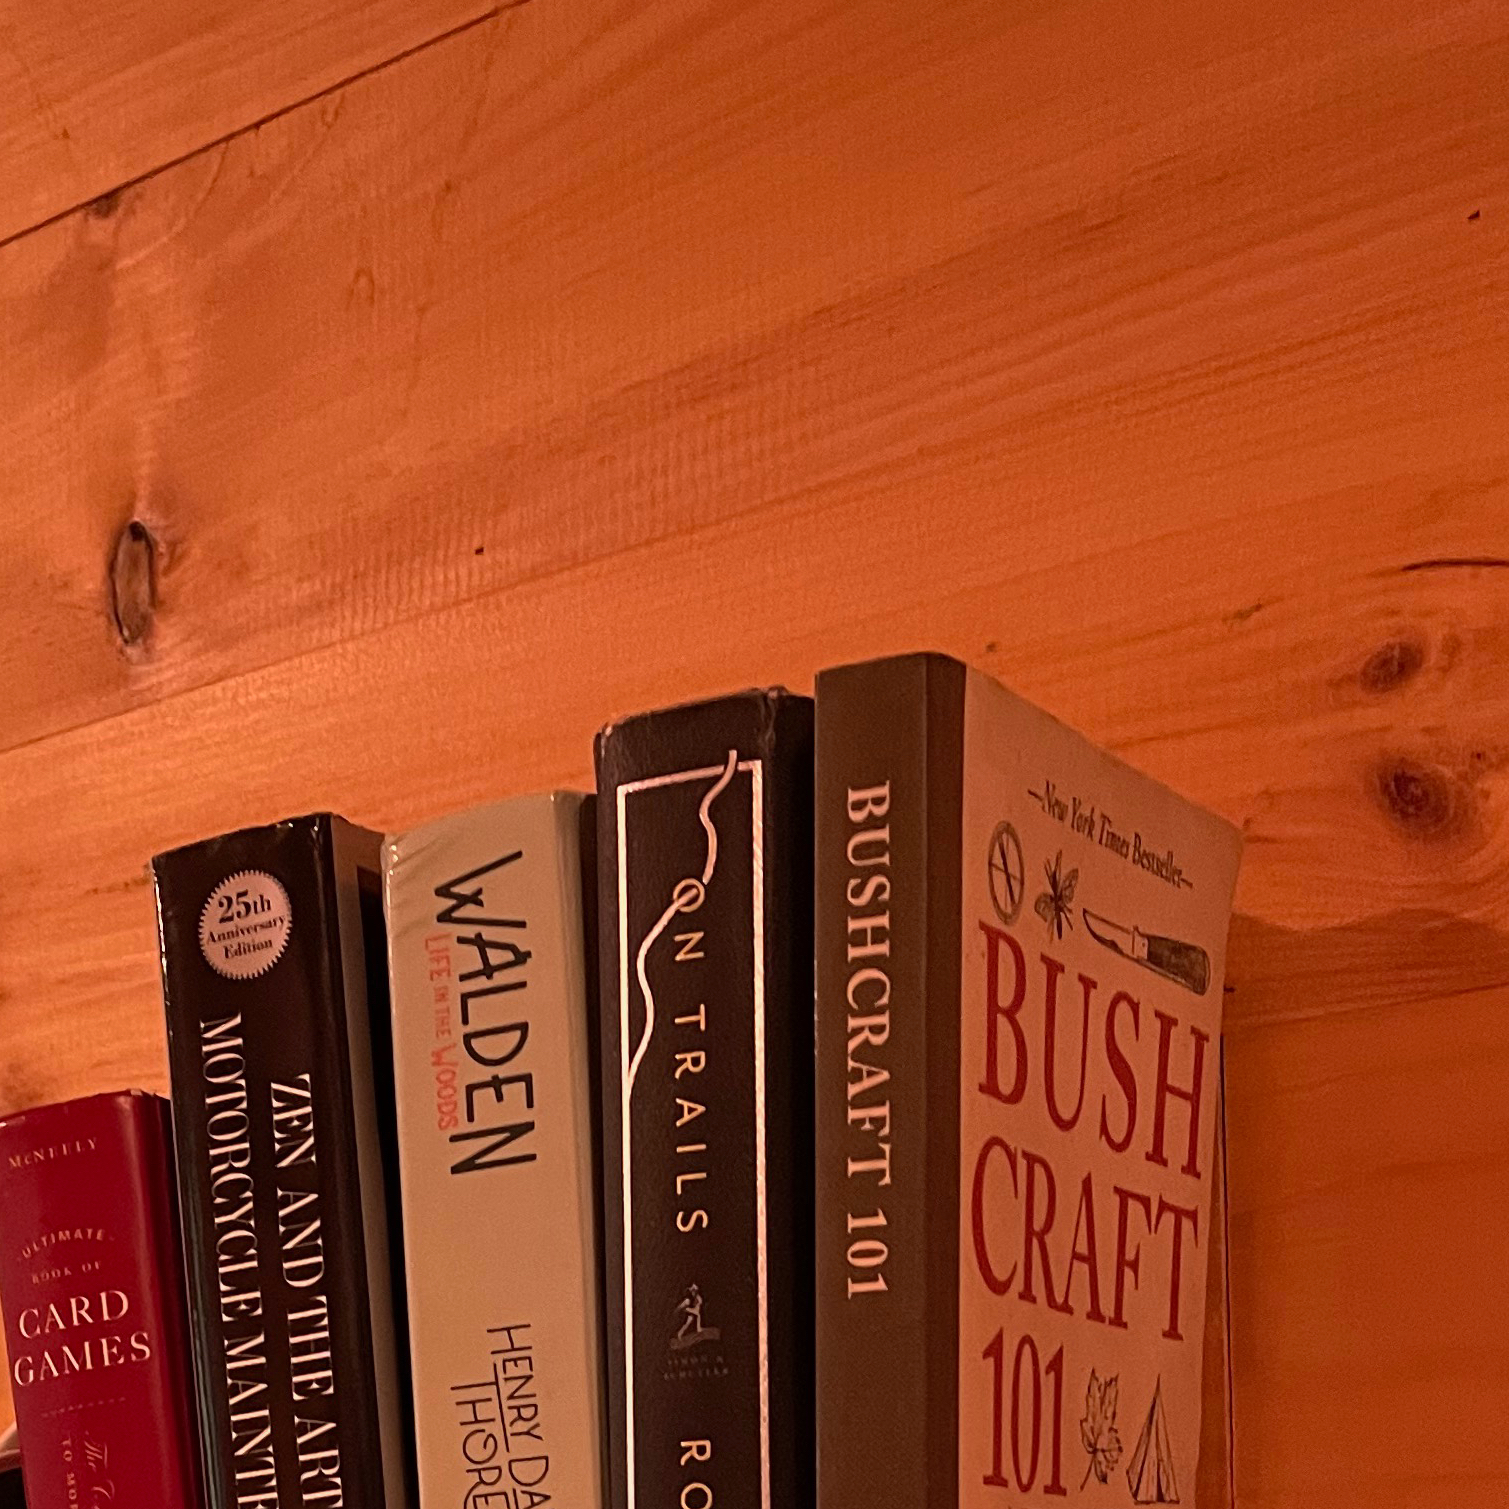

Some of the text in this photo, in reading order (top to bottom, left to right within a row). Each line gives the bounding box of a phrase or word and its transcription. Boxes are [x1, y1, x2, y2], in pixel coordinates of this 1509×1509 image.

[1070, 797, 1097, 842] York
[1098, 812, 1131, 861] Times
[206, 914, 286, 945] Anniversary
[218, 889, 271, 923] 25th
[223, 936, 273, 960] Edition
[425, 932, 458, 1131] LIFE IN THE WOODS
[435, 851, 537, 1175] WALDEN
[673, 878, 708, 1232] ON TRAILS
[846, 780, 891, 1299] BUSHCRAFT 101
[978, 920, 1209, 1179] BUSH
[200, 1012, 263, 1322] MOTORCYCLE
[271, 1074, 318, 1168] ZEN
[21, 1227, 105, 1259] ULTIMATE
[31, 1261, 101, 1285] BOOK OF
[276, 1186, 325, 1288] AND
[971, 1136, 1199, 1341] CRAFT
[13, 1331, 151, 1387] GAMES
[19, 1289, 129, 1339] CARD
[288, 1296, 334, 1400] THE
[487, 1324, 543, 1441] HENRY
[982, 1326, 1067, 1496] 101
[60, 1436, 72, 1463] TO
[84, 1431, 108, 1472] The
[294, 1415, 343, 1508] ART
